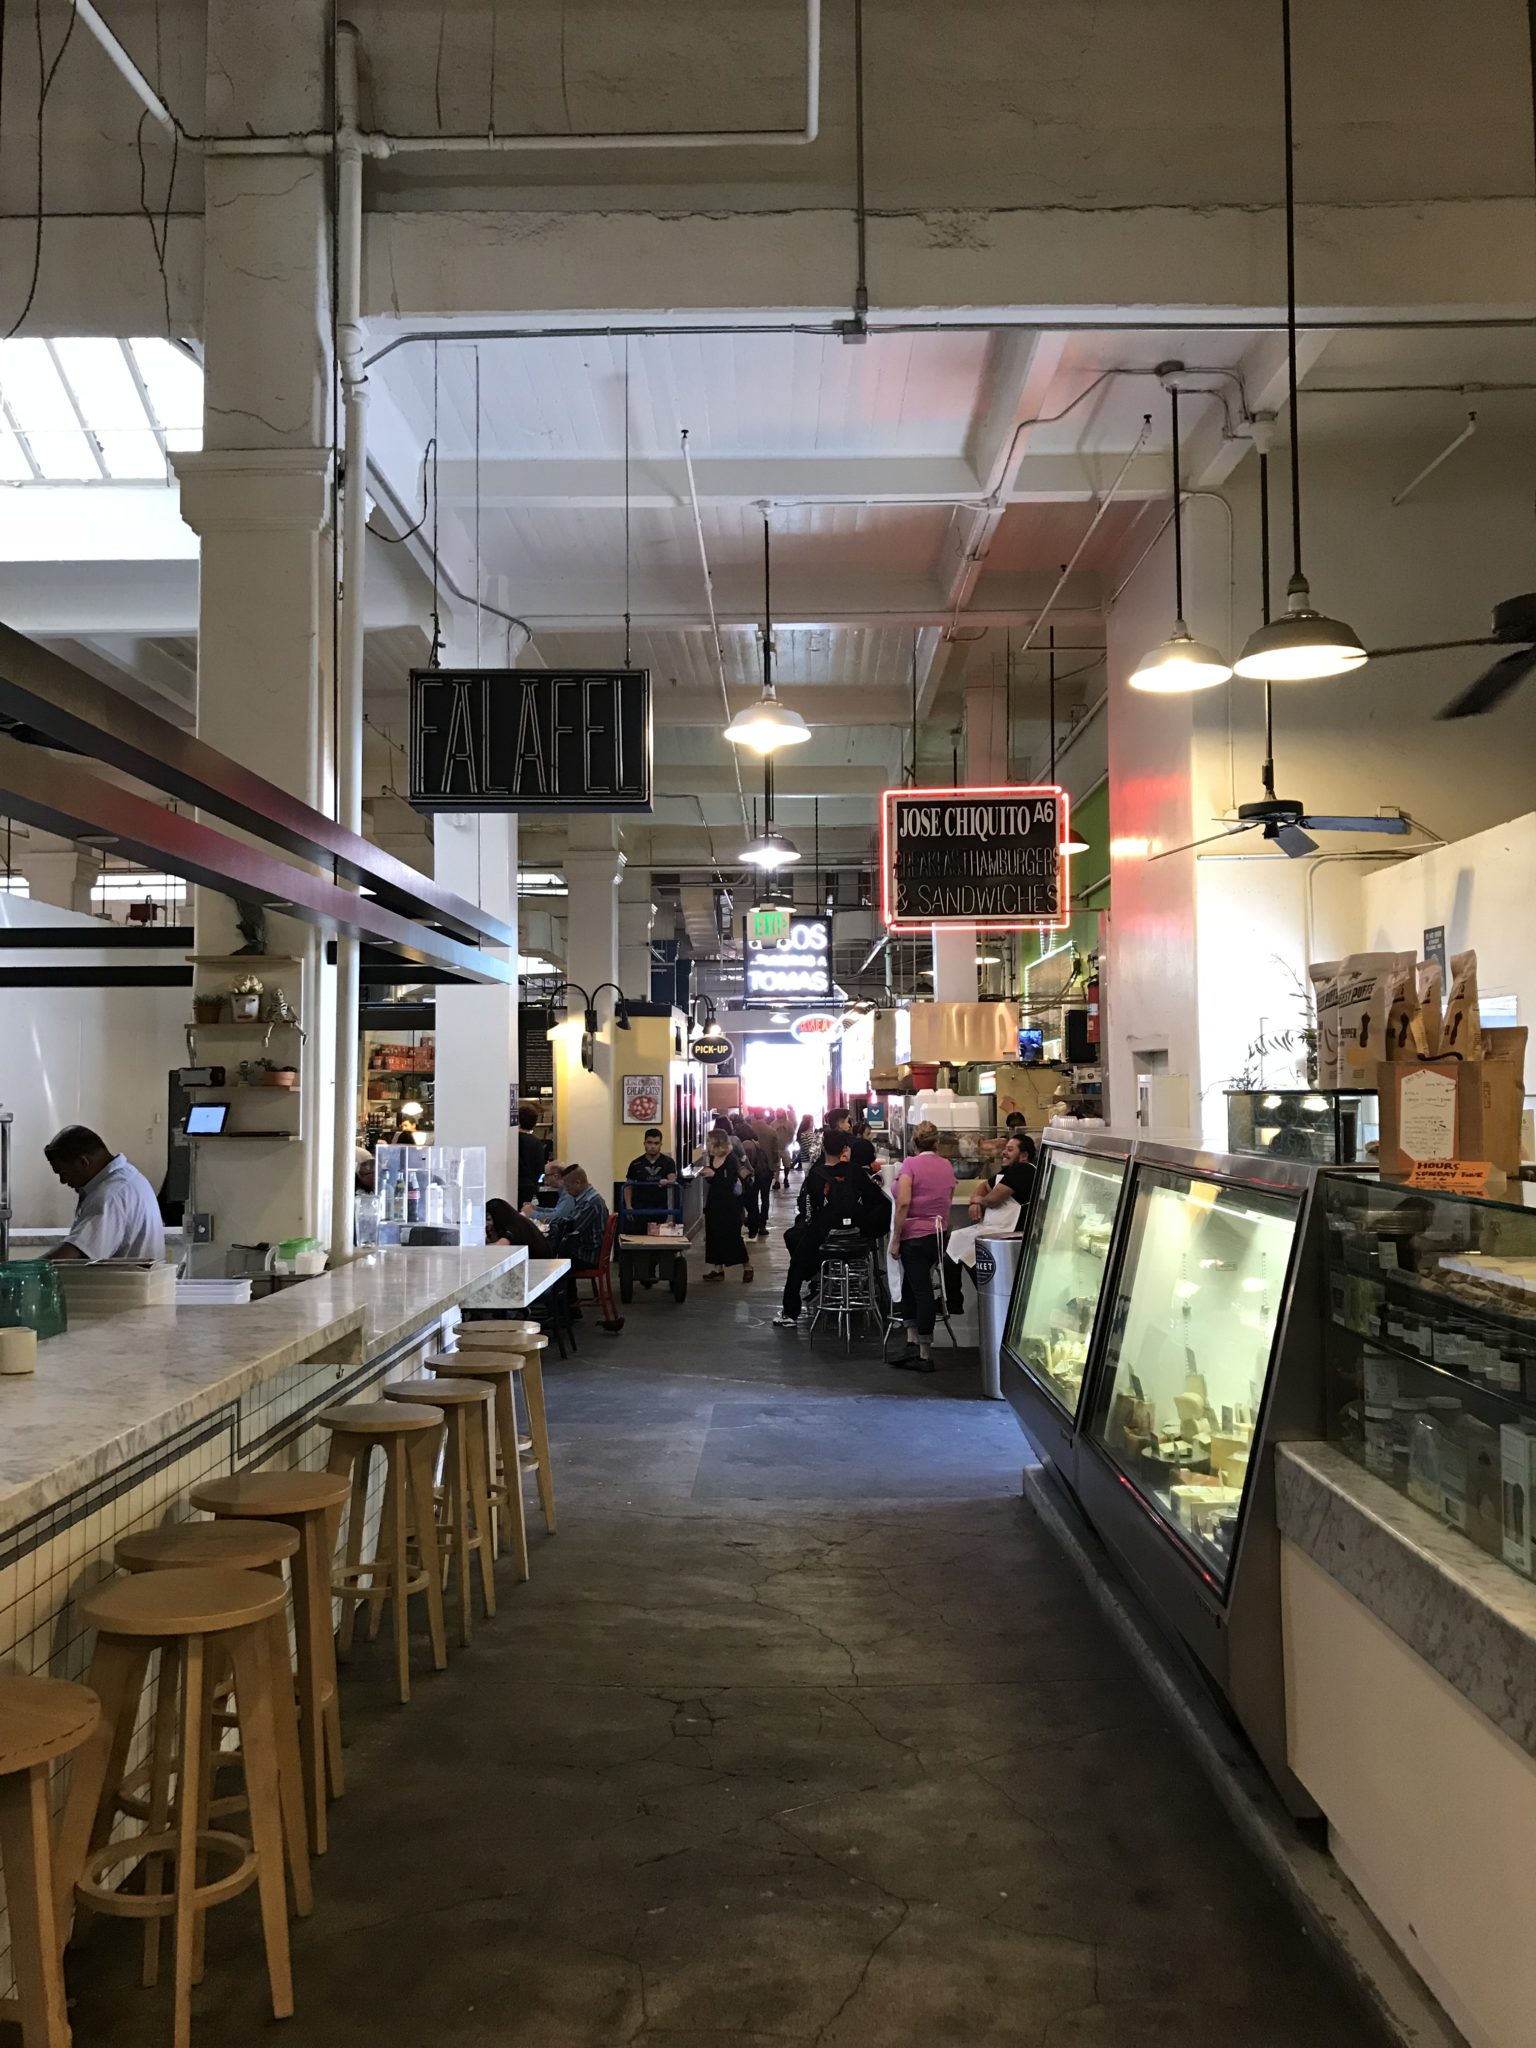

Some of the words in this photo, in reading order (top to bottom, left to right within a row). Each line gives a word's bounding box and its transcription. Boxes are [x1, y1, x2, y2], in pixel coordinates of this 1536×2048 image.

[415, 678, 642, 794] FALAFEL
[900, 807, 941, 838] JOSE
[944, 806, 1031, 842] CHIQUITO
[1033, 801, 1053, 823] A6
[969, 847, 1059, 877] HAMBURGERS
[896, 883, 908, 912] &
[918, 883, 1057, 915] SANDWICHES
[754, 913, 783, 936] EXIT
[695, 1045, 729, 1054] PICK-UP
[626, 1086, 645, 1096] CHEAP
[1415, 1170, 1457, 1178] SUNDAY
[1417, 1162, 1460, 1171] HOURS
